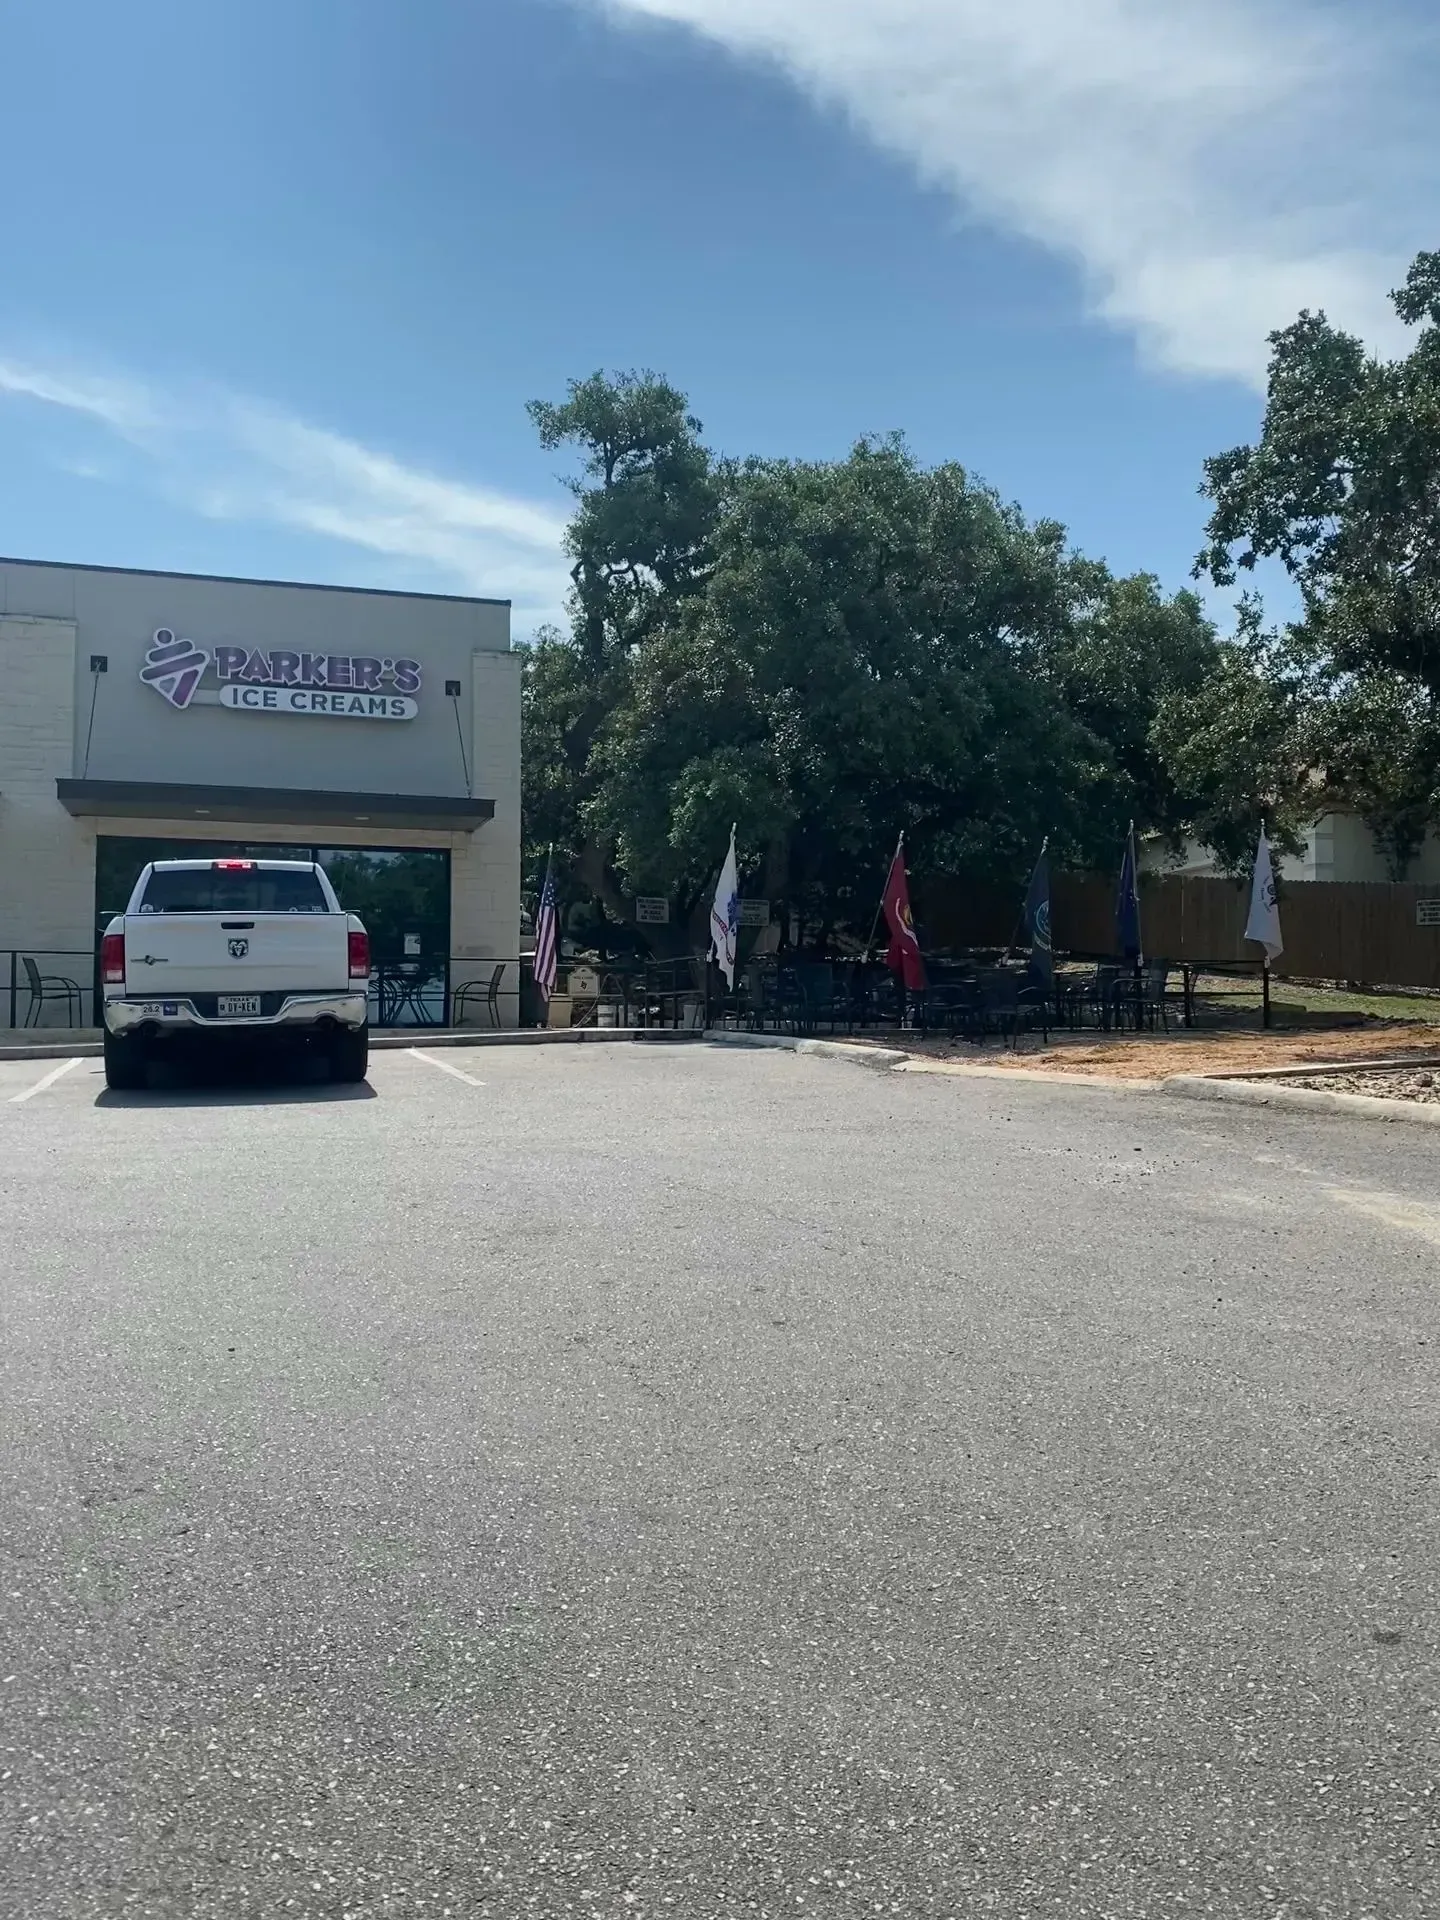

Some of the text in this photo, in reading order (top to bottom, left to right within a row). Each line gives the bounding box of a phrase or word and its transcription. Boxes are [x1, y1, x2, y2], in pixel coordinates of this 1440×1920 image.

[214, 646, 421, 693] PARKER'S
[232, 687, 406, 717] ICE CREAMS
